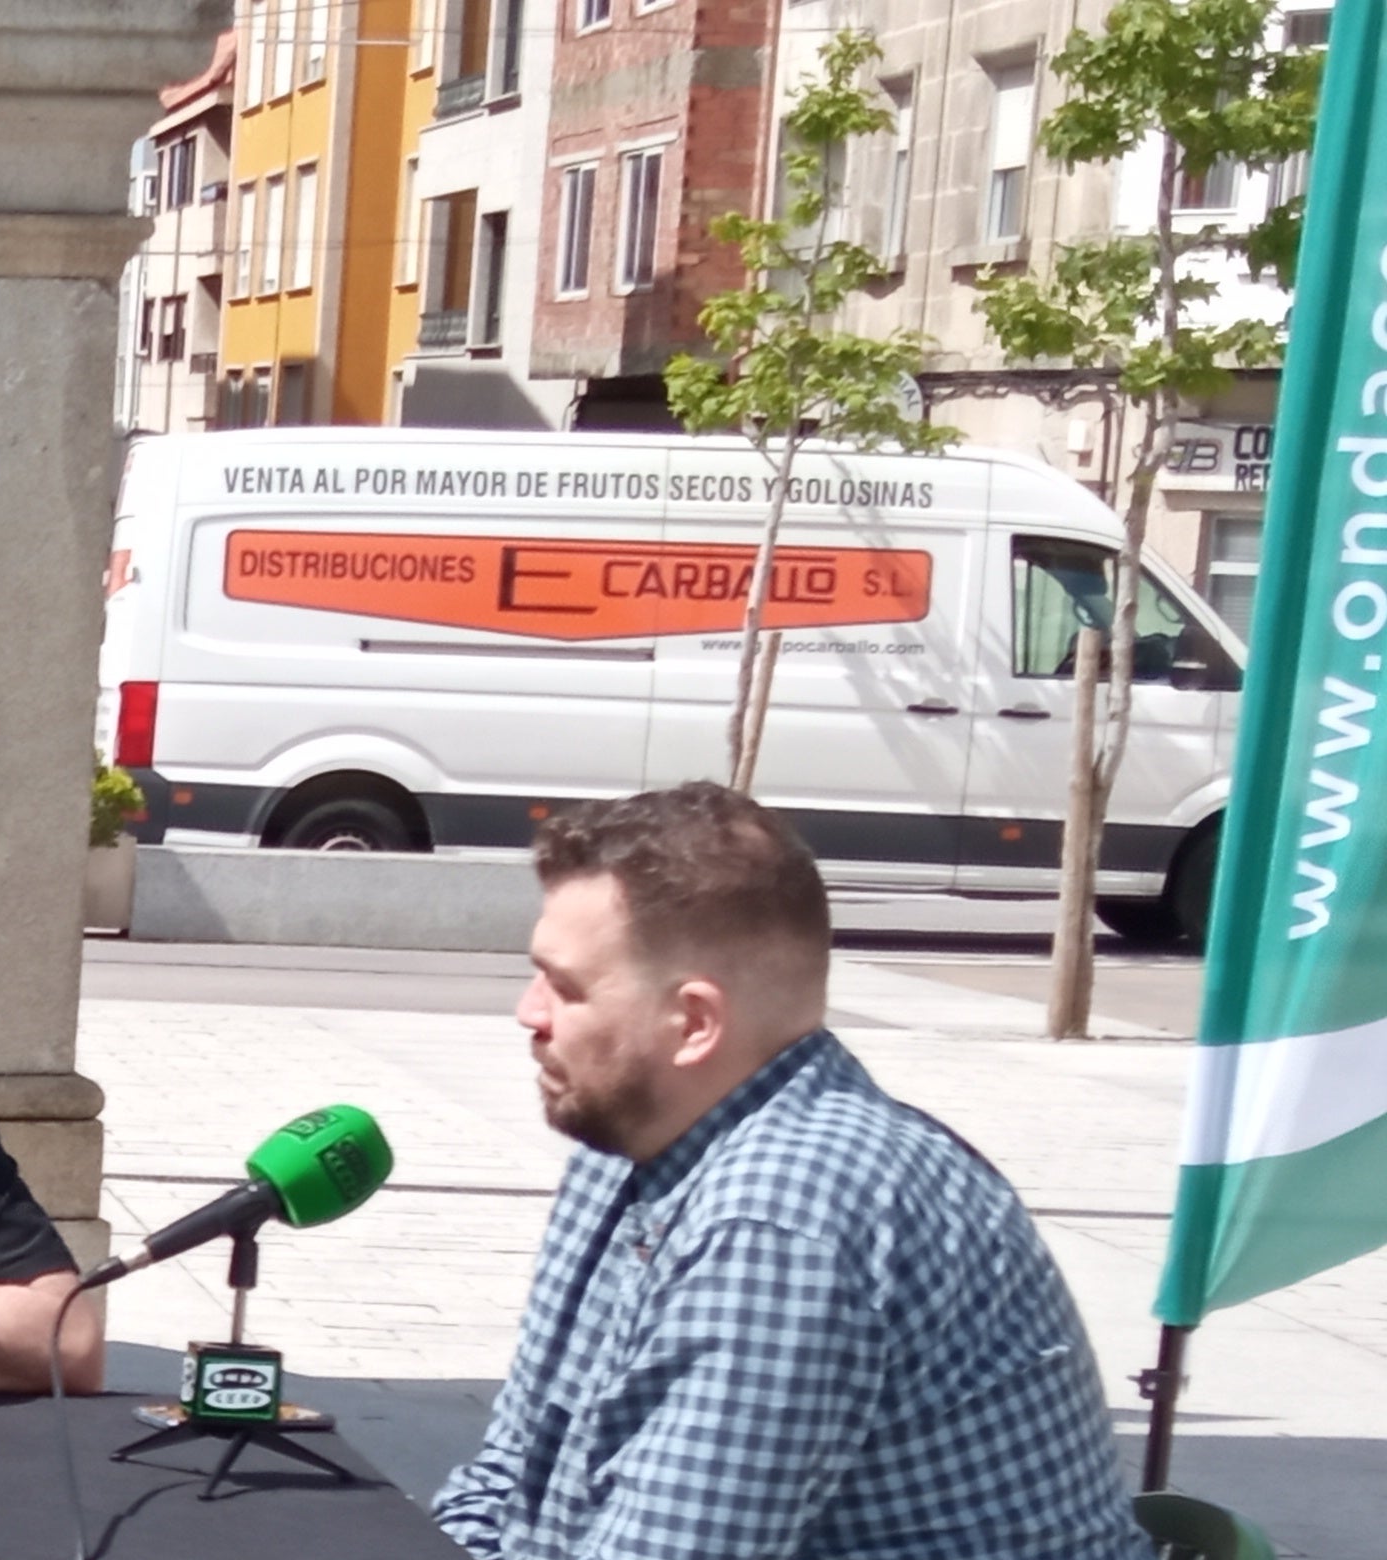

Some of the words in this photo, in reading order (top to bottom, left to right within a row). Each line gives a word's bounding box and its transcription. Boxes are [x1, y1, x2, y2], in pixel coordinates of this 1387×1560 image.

[1234, 425, 1274, 460] CO
[225, 467, 305, 494] VENTA
[313, 468, 343, 494] AL
[355, 469, 406, 496] POR
[416, 470, 507, 497] MAYOR
[517, 471, 549, 498] DE
[557, 472, 659, 500] FRUTOS
[669, 474, 753, 503] SECOS
[763, 477, 778, 501] Y
[788, 478, 933, 508] GOLOSINAS
[239, 549, 476, 583] DISTRIBUCIONES
